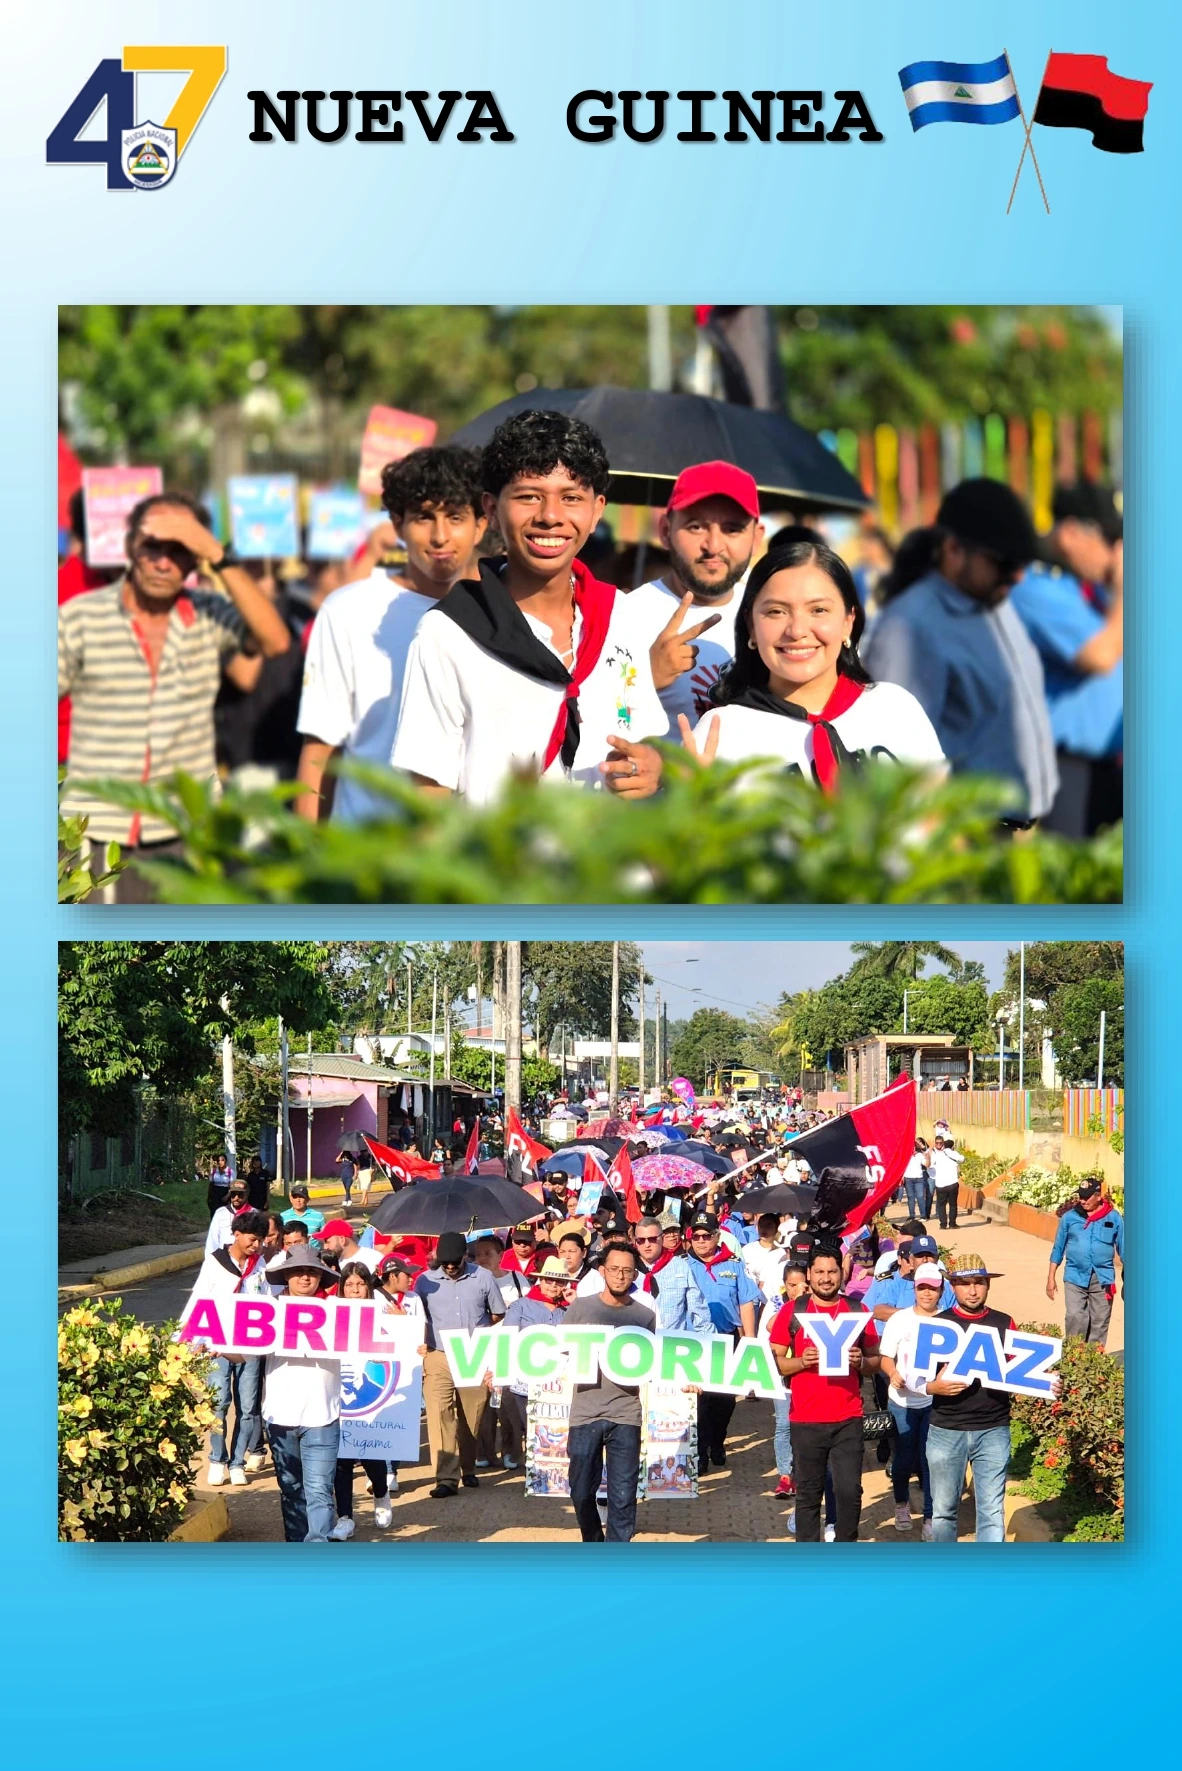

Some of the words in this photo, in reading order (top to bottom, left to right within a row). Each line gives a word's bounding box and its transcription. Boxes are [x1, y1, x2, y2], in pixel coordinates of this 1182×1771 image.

[178, 1299, 395, 1354] ABRIL
[808, 1320, 860, 1368] Y
[449, 1331, 776, 1391] VICTORIA
[914, 1322, 1055, 1391] PAZ
[340, 1429, 393, 1456] Rugama
[356, 1420, 407, 1431] CULTURAL
